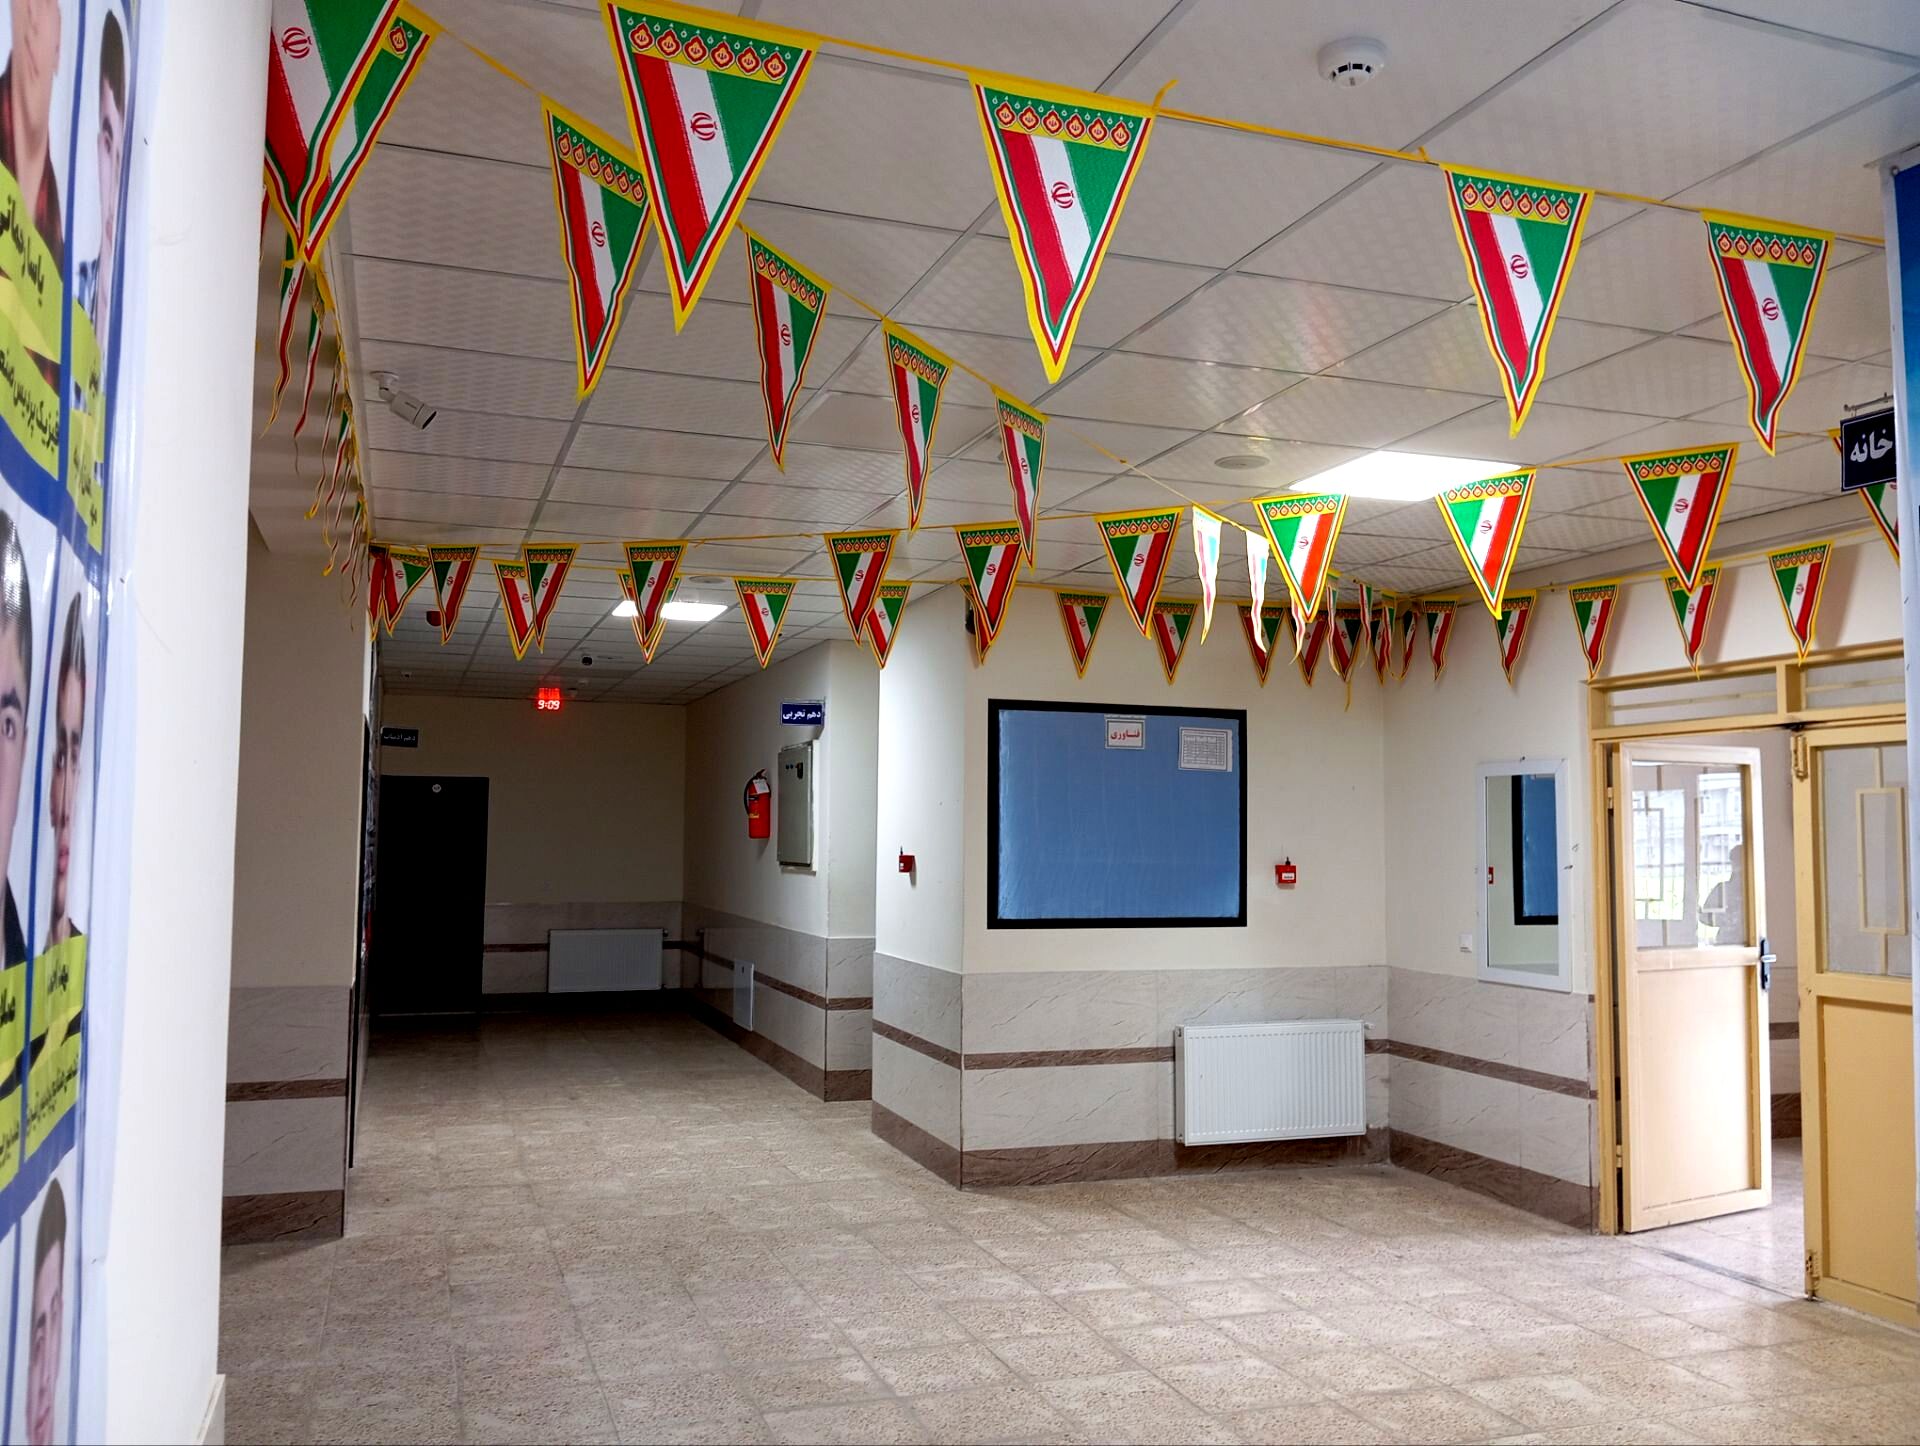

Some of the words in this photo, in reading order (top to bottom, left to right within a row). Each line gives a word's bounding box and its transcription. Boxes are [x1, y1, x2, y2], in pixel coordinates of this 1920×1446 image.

[538, 699, 560, 710] 9:09
[782, 709, 806, 720] تجربی
[807, 711, 821, 720] دهم
[1110, 728, 1141, 741] فناوری
